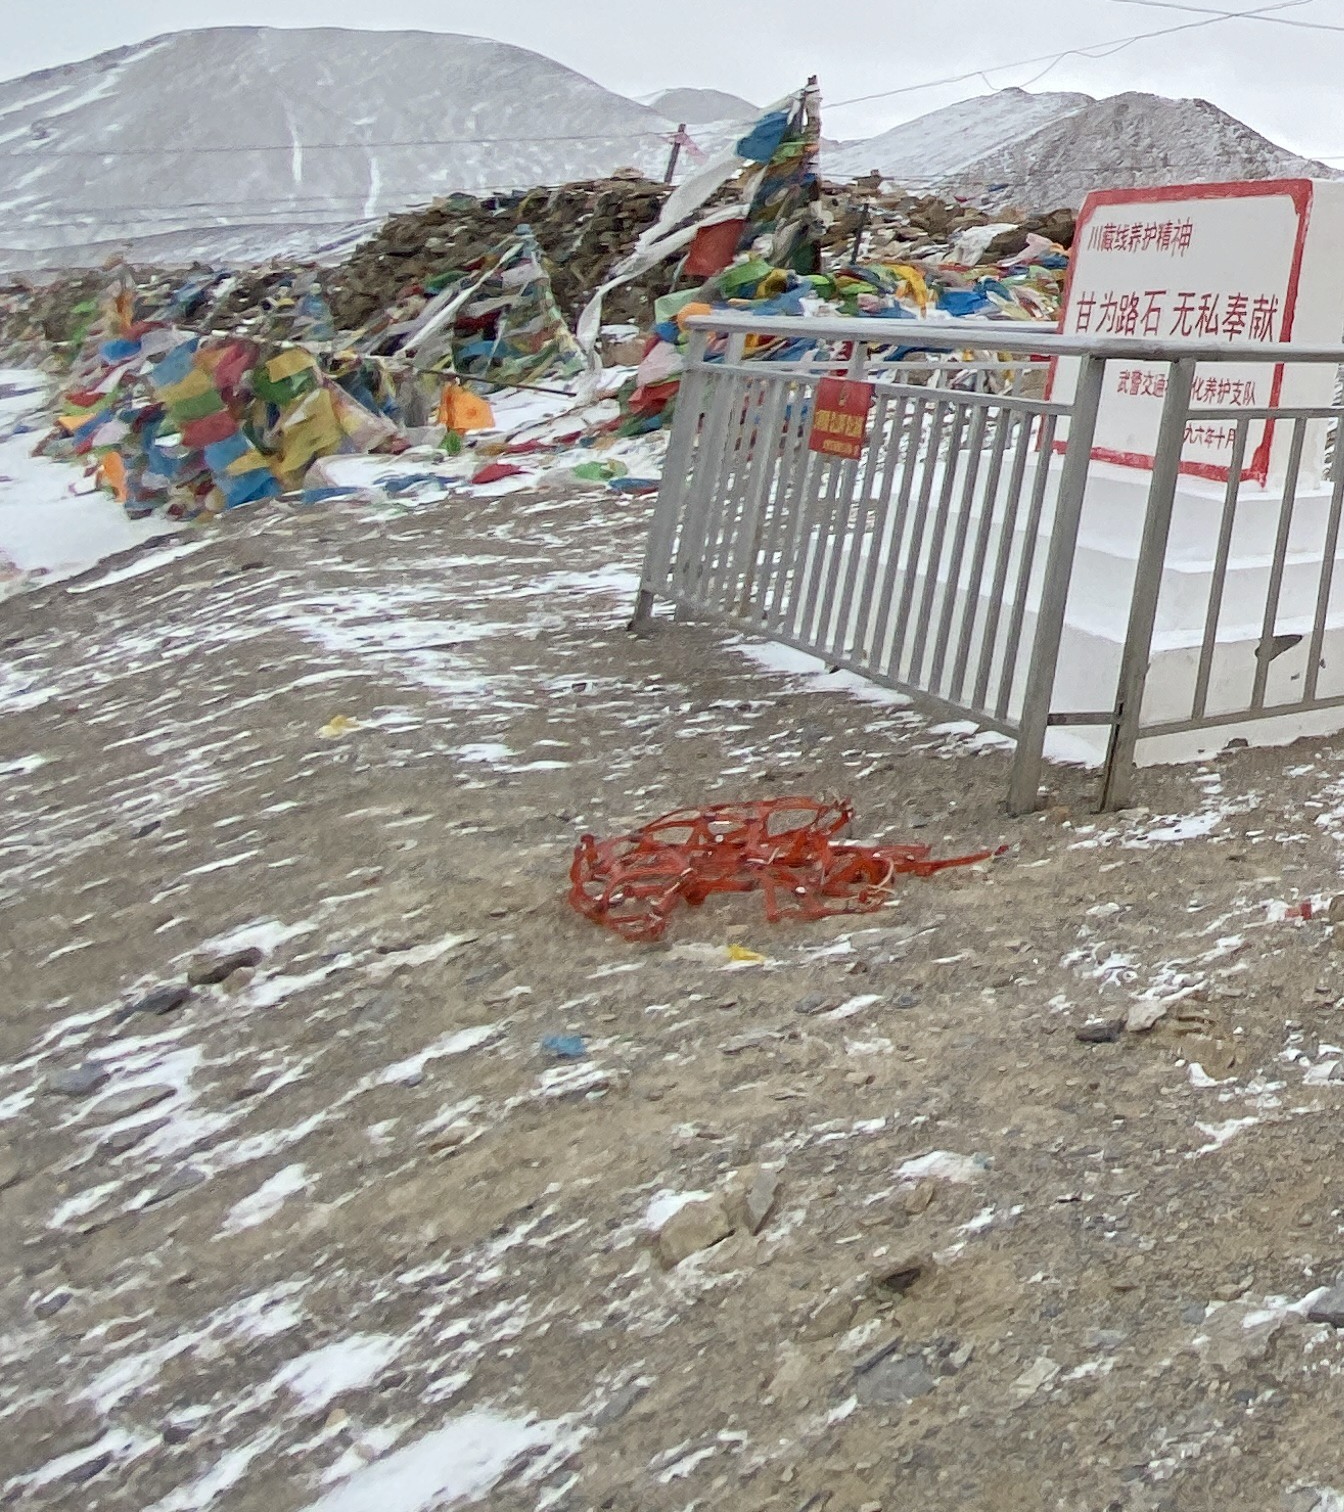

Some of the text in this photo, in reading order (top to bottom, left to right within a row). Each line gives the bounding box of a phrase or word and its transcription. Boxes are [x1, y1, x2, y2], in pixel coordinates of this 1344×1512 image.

[1087, 216, 1193, 257] 川藏线养护精神
[1075, 289, 1279, 343] 甘为路石 无私奉献
